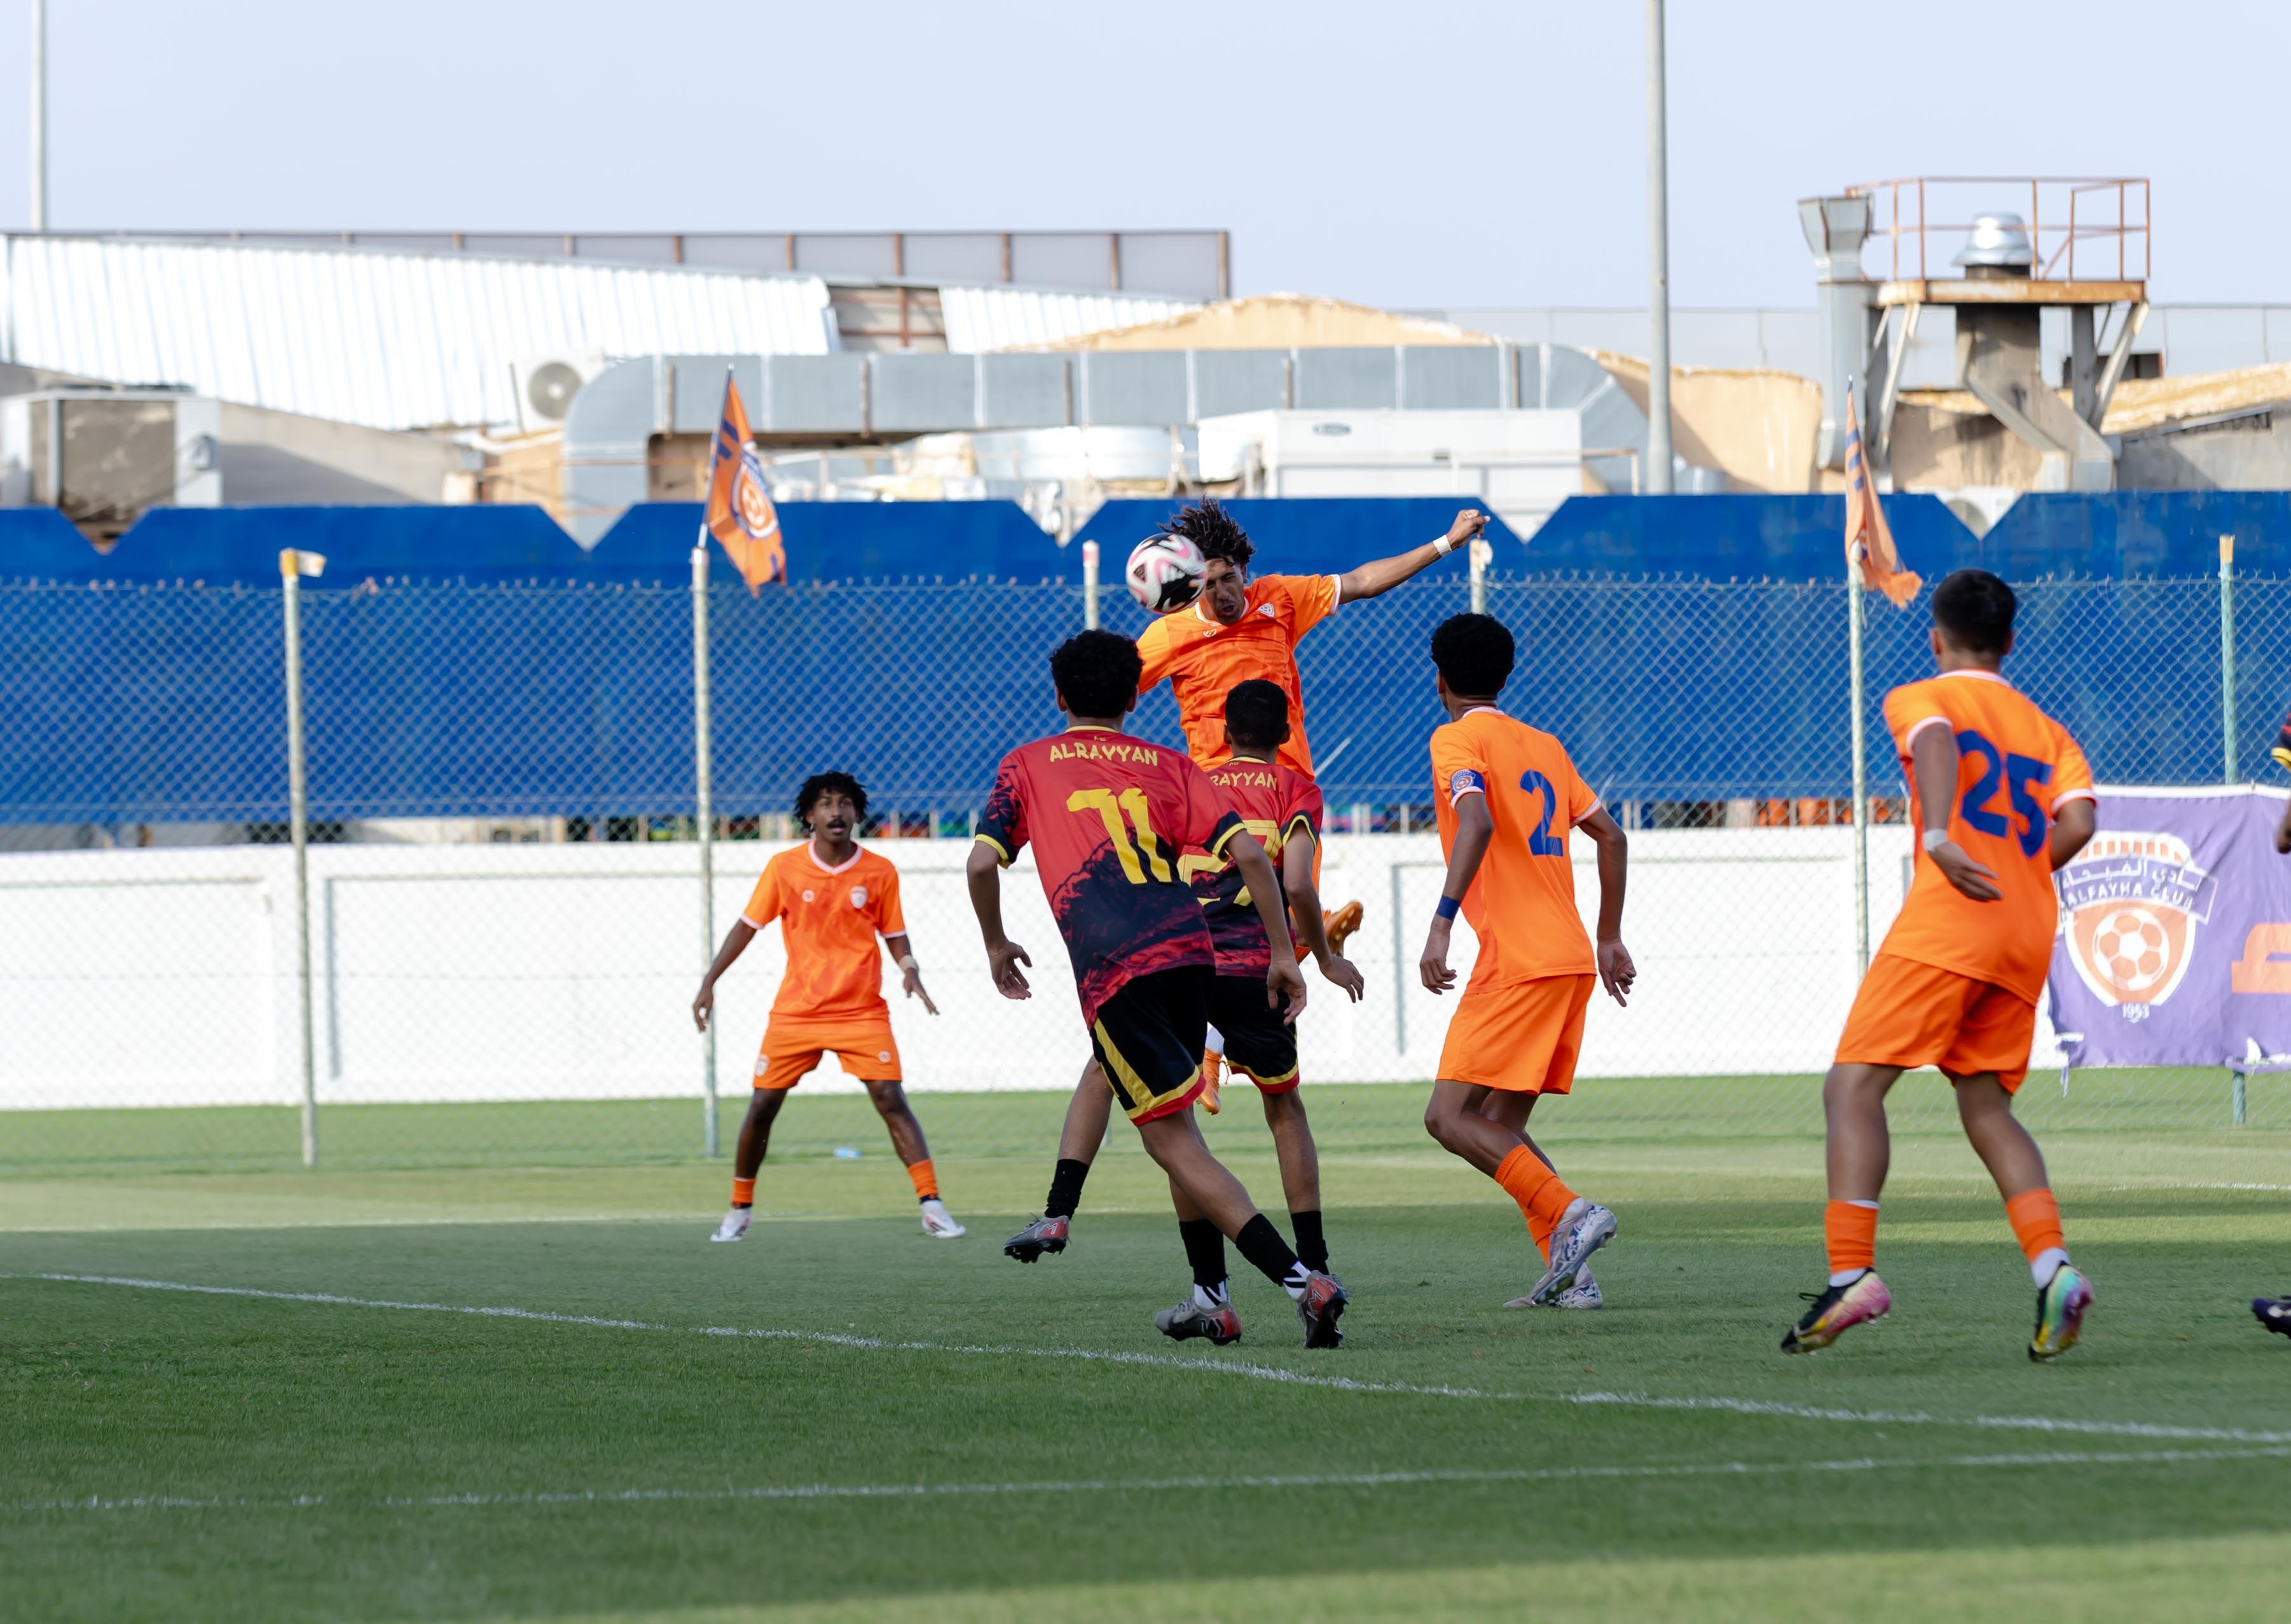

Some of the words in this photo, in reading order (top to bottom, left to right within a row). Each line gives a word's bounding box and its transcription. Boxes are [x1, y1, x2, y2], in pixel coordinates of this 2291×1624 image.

[1049, 741, 1158, 766] ALRAYYAN
[1519, 769, 1564, 857] 2
[1955, 729, 2054, 860] 25
[2067, 882, 2143, 905] ALFAYHA
